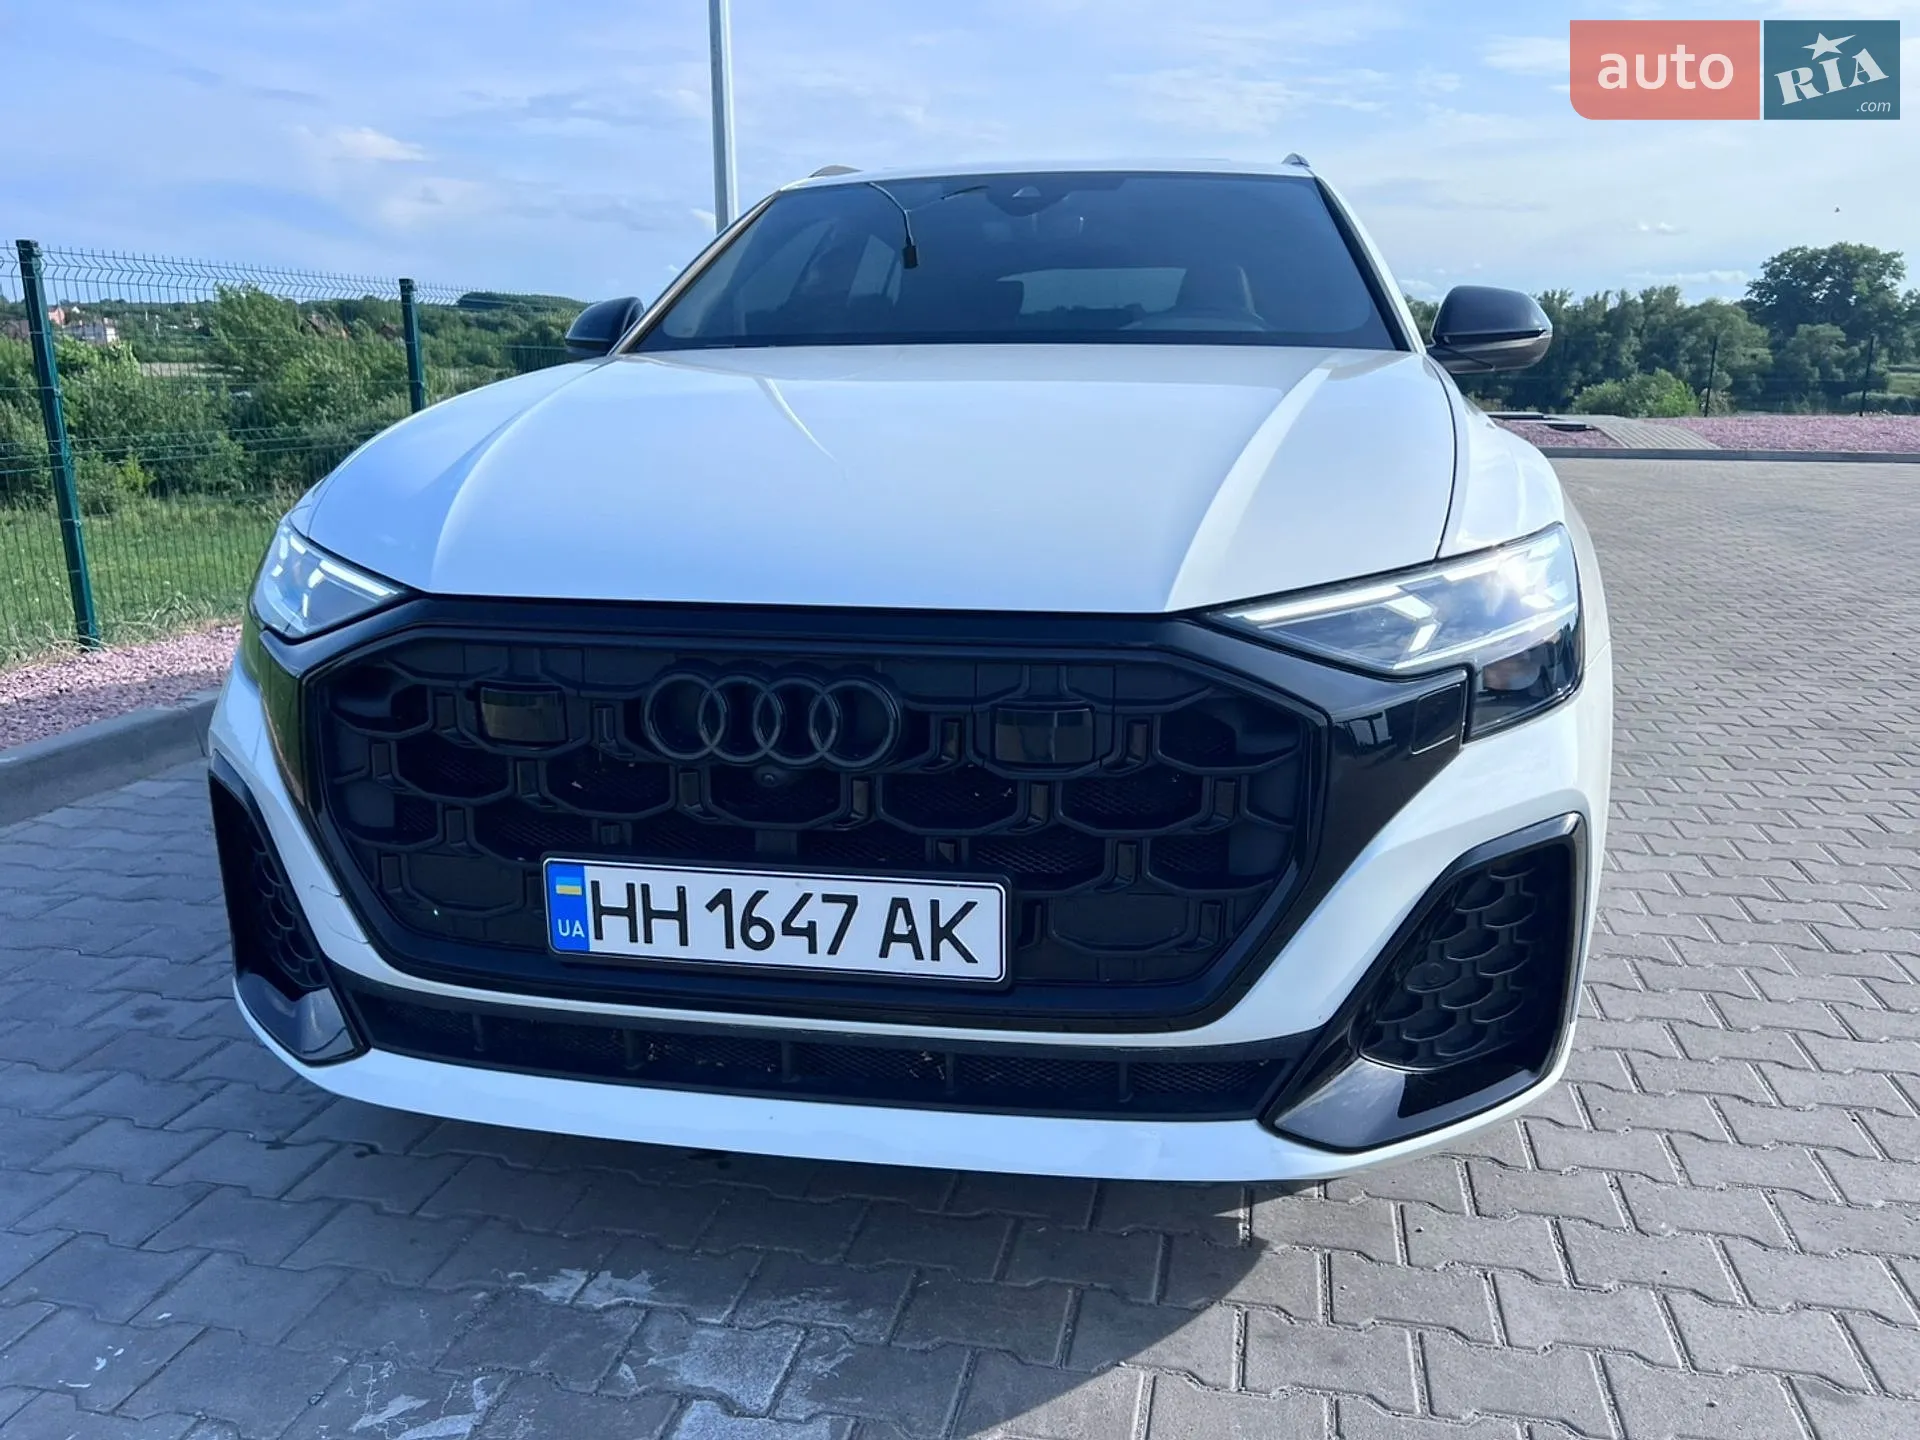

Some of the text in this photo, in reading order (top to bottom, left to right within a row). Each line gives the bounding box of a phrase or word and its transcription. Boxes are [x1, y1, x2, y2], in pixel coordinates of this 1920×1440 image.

[558, 919, 585, 938] UA
[591, 880, 978, 964] HH 1647 AK
